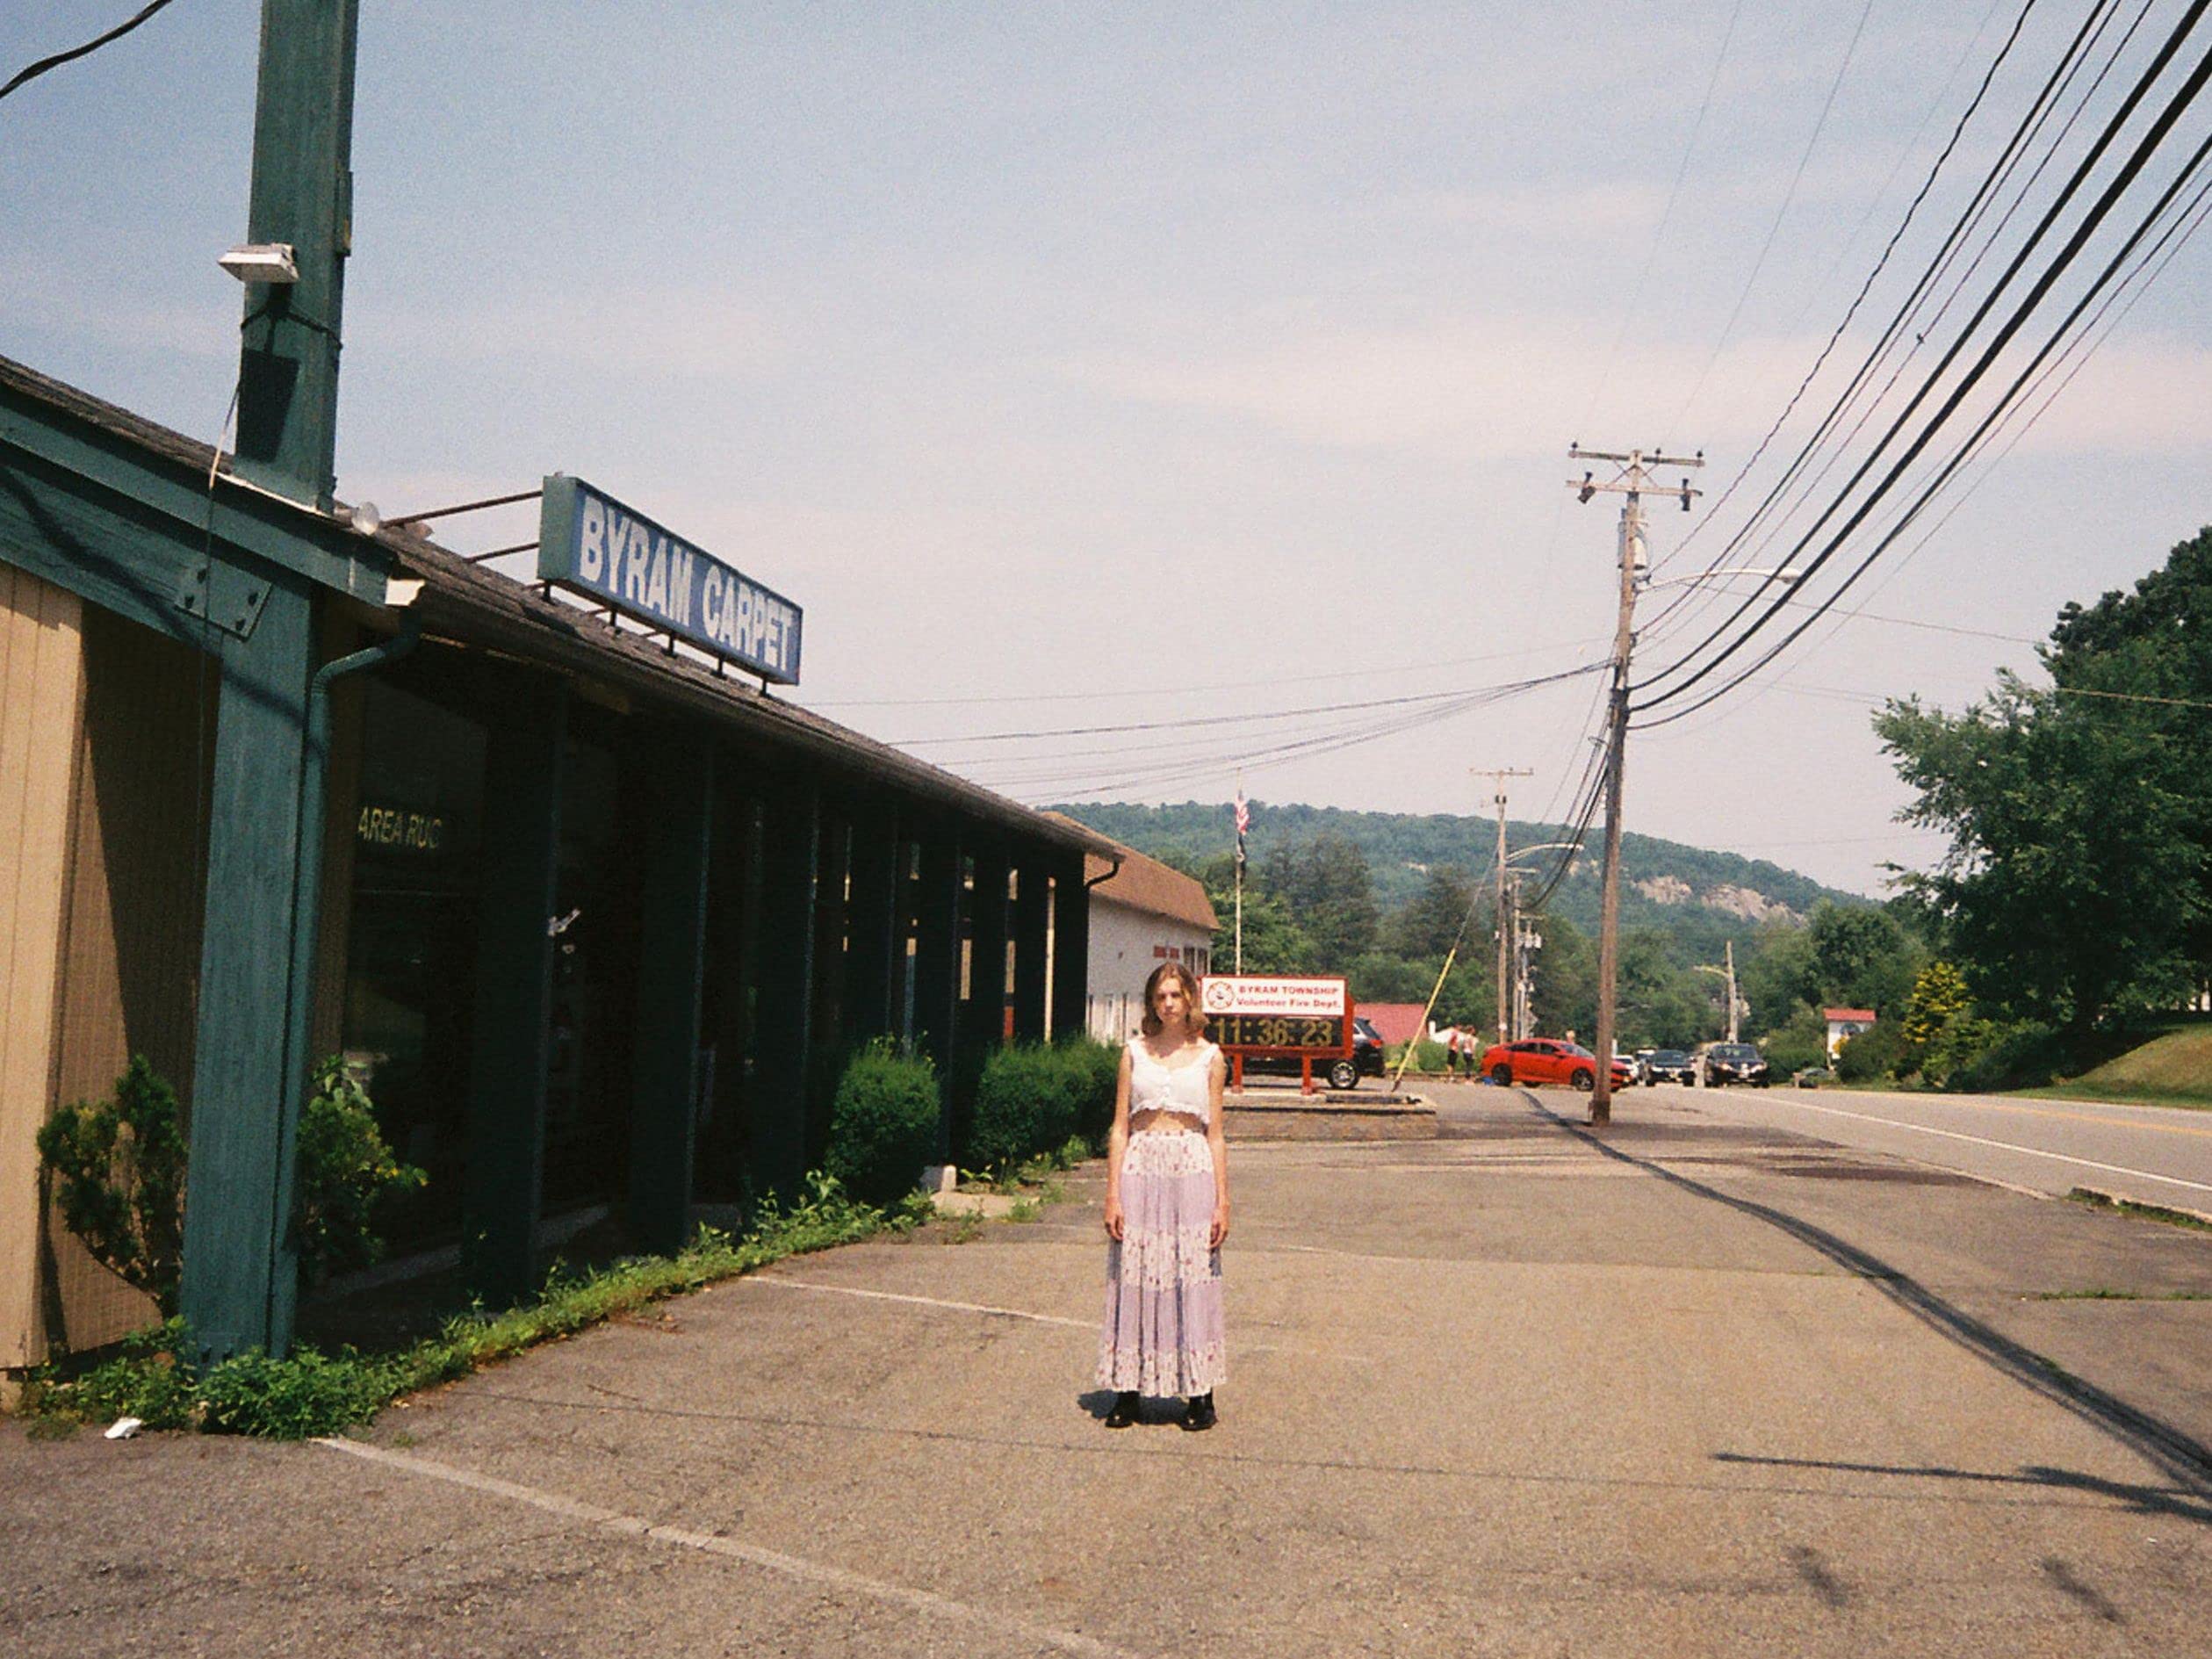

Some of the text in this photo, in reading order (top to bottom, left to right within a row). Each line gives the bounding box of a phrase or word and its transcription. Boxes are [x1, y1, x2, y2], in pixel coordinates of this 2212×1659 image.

[579, 494, 794, 673] BYRAM CARPET
[358, 805, 403, 844] AREA
[1236, 998, 1342, 1010] Volunteer Fire Dept.
[1239, 985, 1339, 995] BYRAM TOWNSHIP
[1215, 1018, 1333, 1046] 11:36:23
